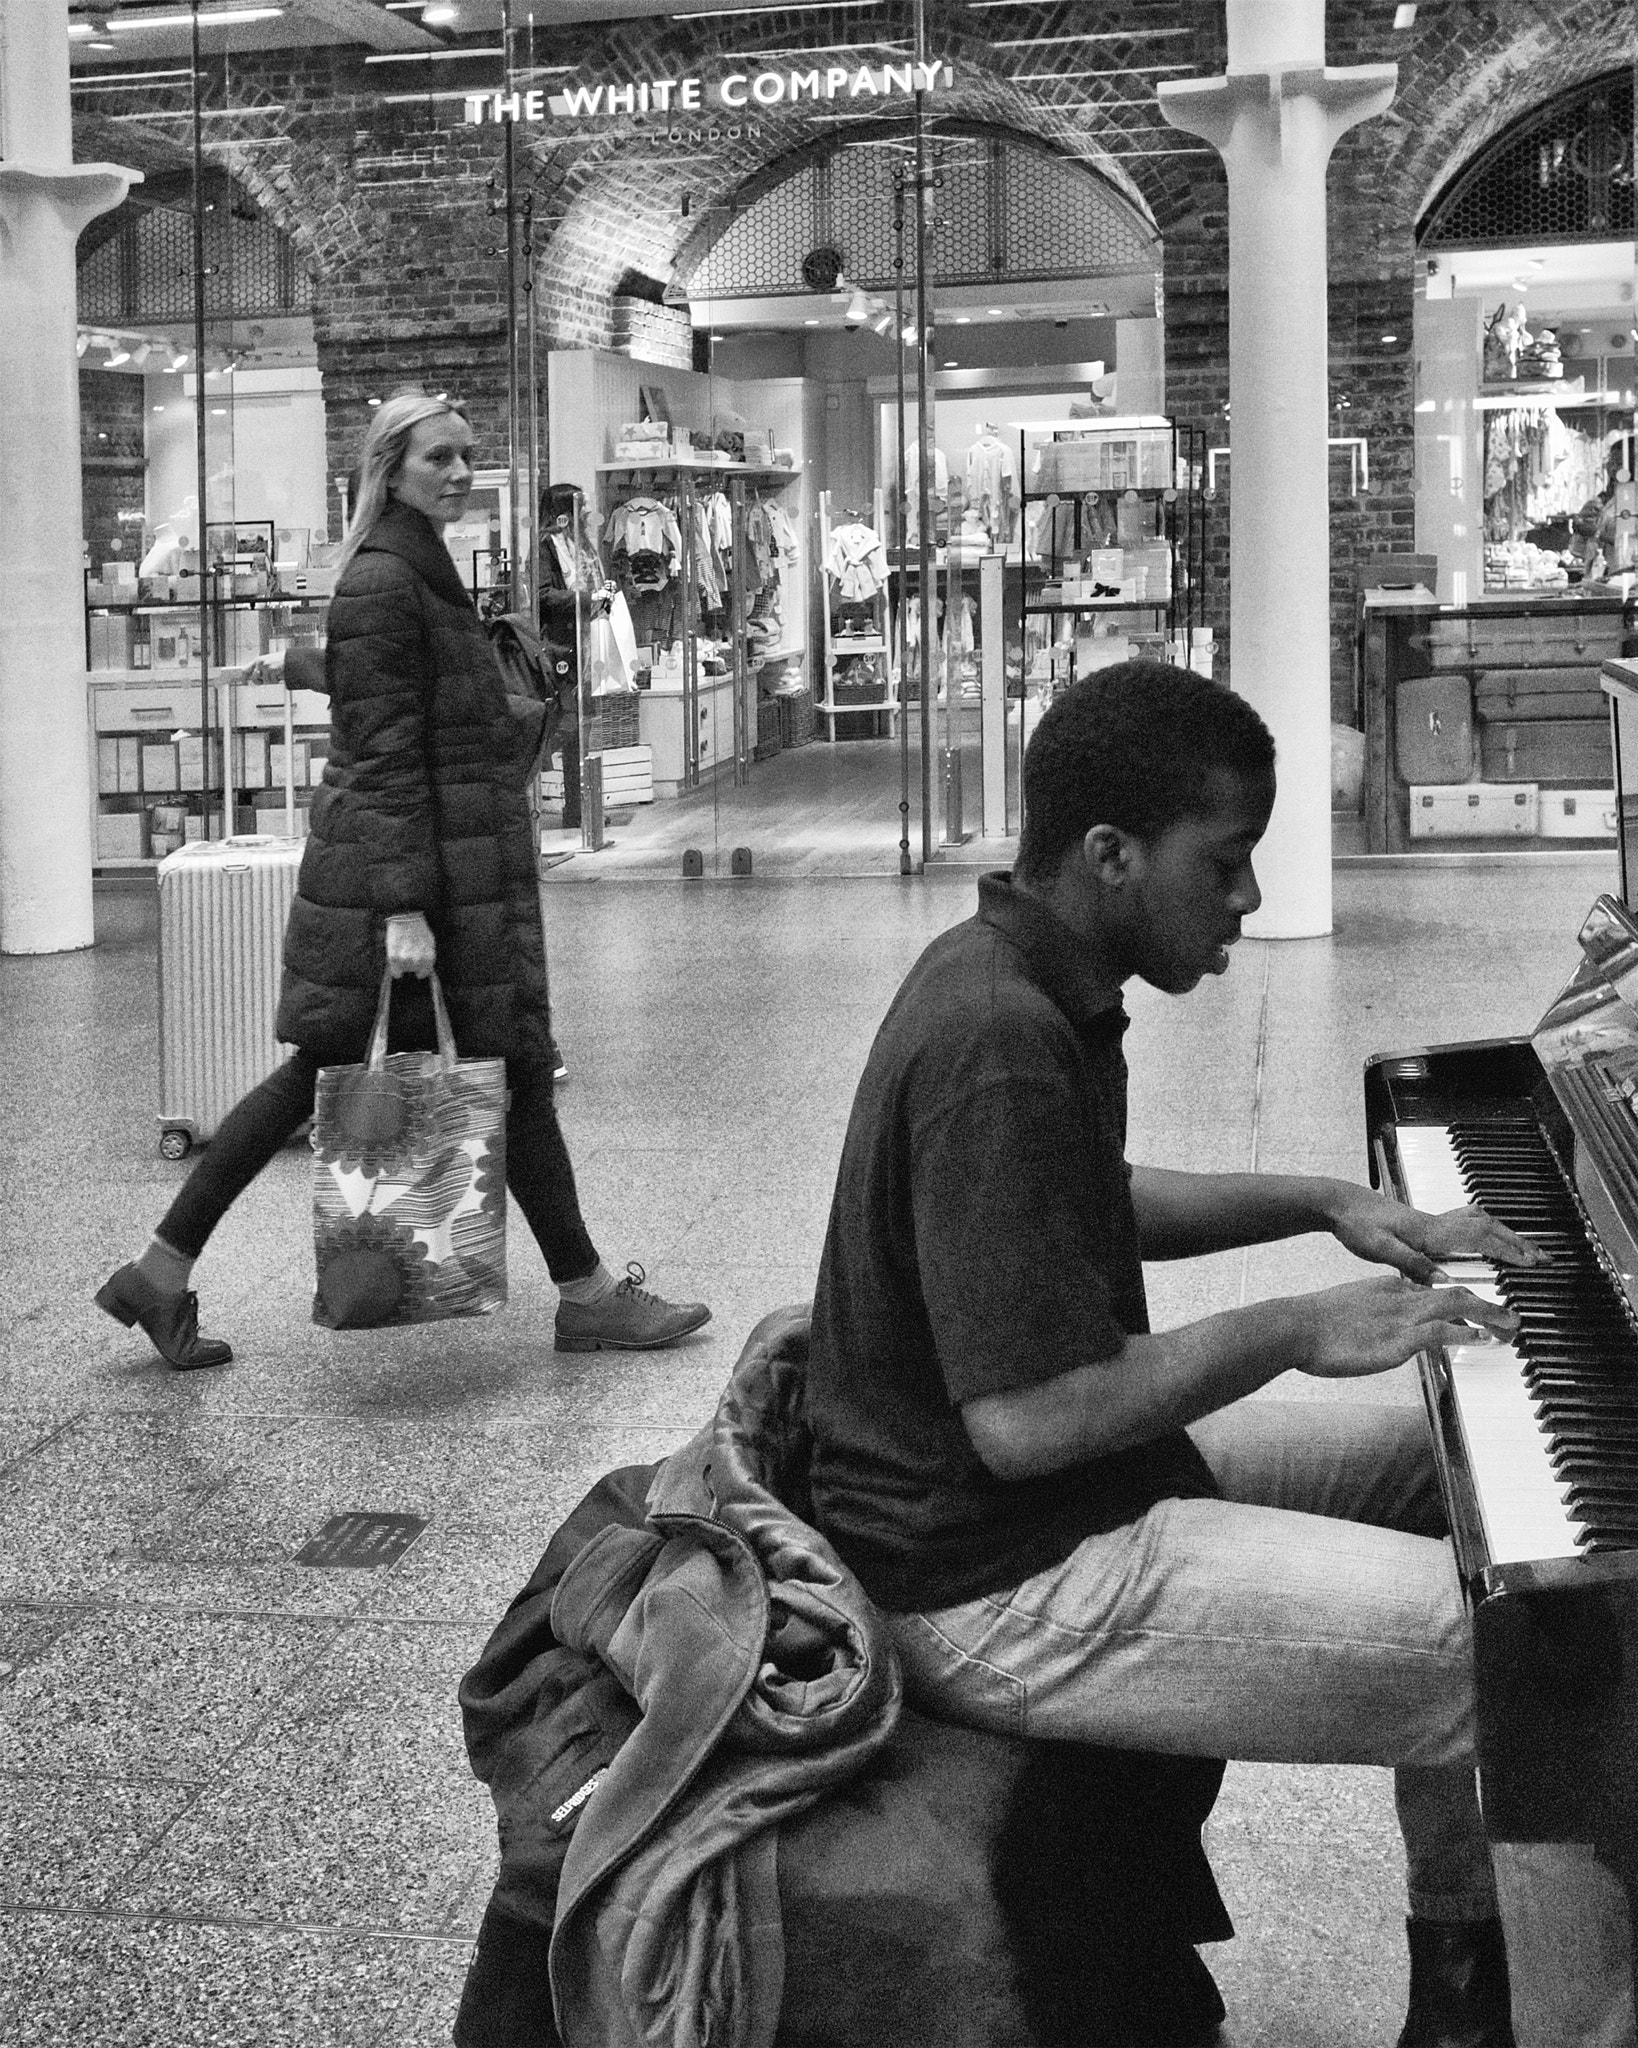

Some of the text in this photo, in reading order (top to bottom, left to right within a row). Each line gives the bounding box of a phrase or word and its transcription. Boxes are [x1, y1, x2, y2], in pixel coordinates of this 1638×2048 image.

[467, 60, 943, 125] THE WHITE COMPANY
[651, 125, 762, 146] LONDON
